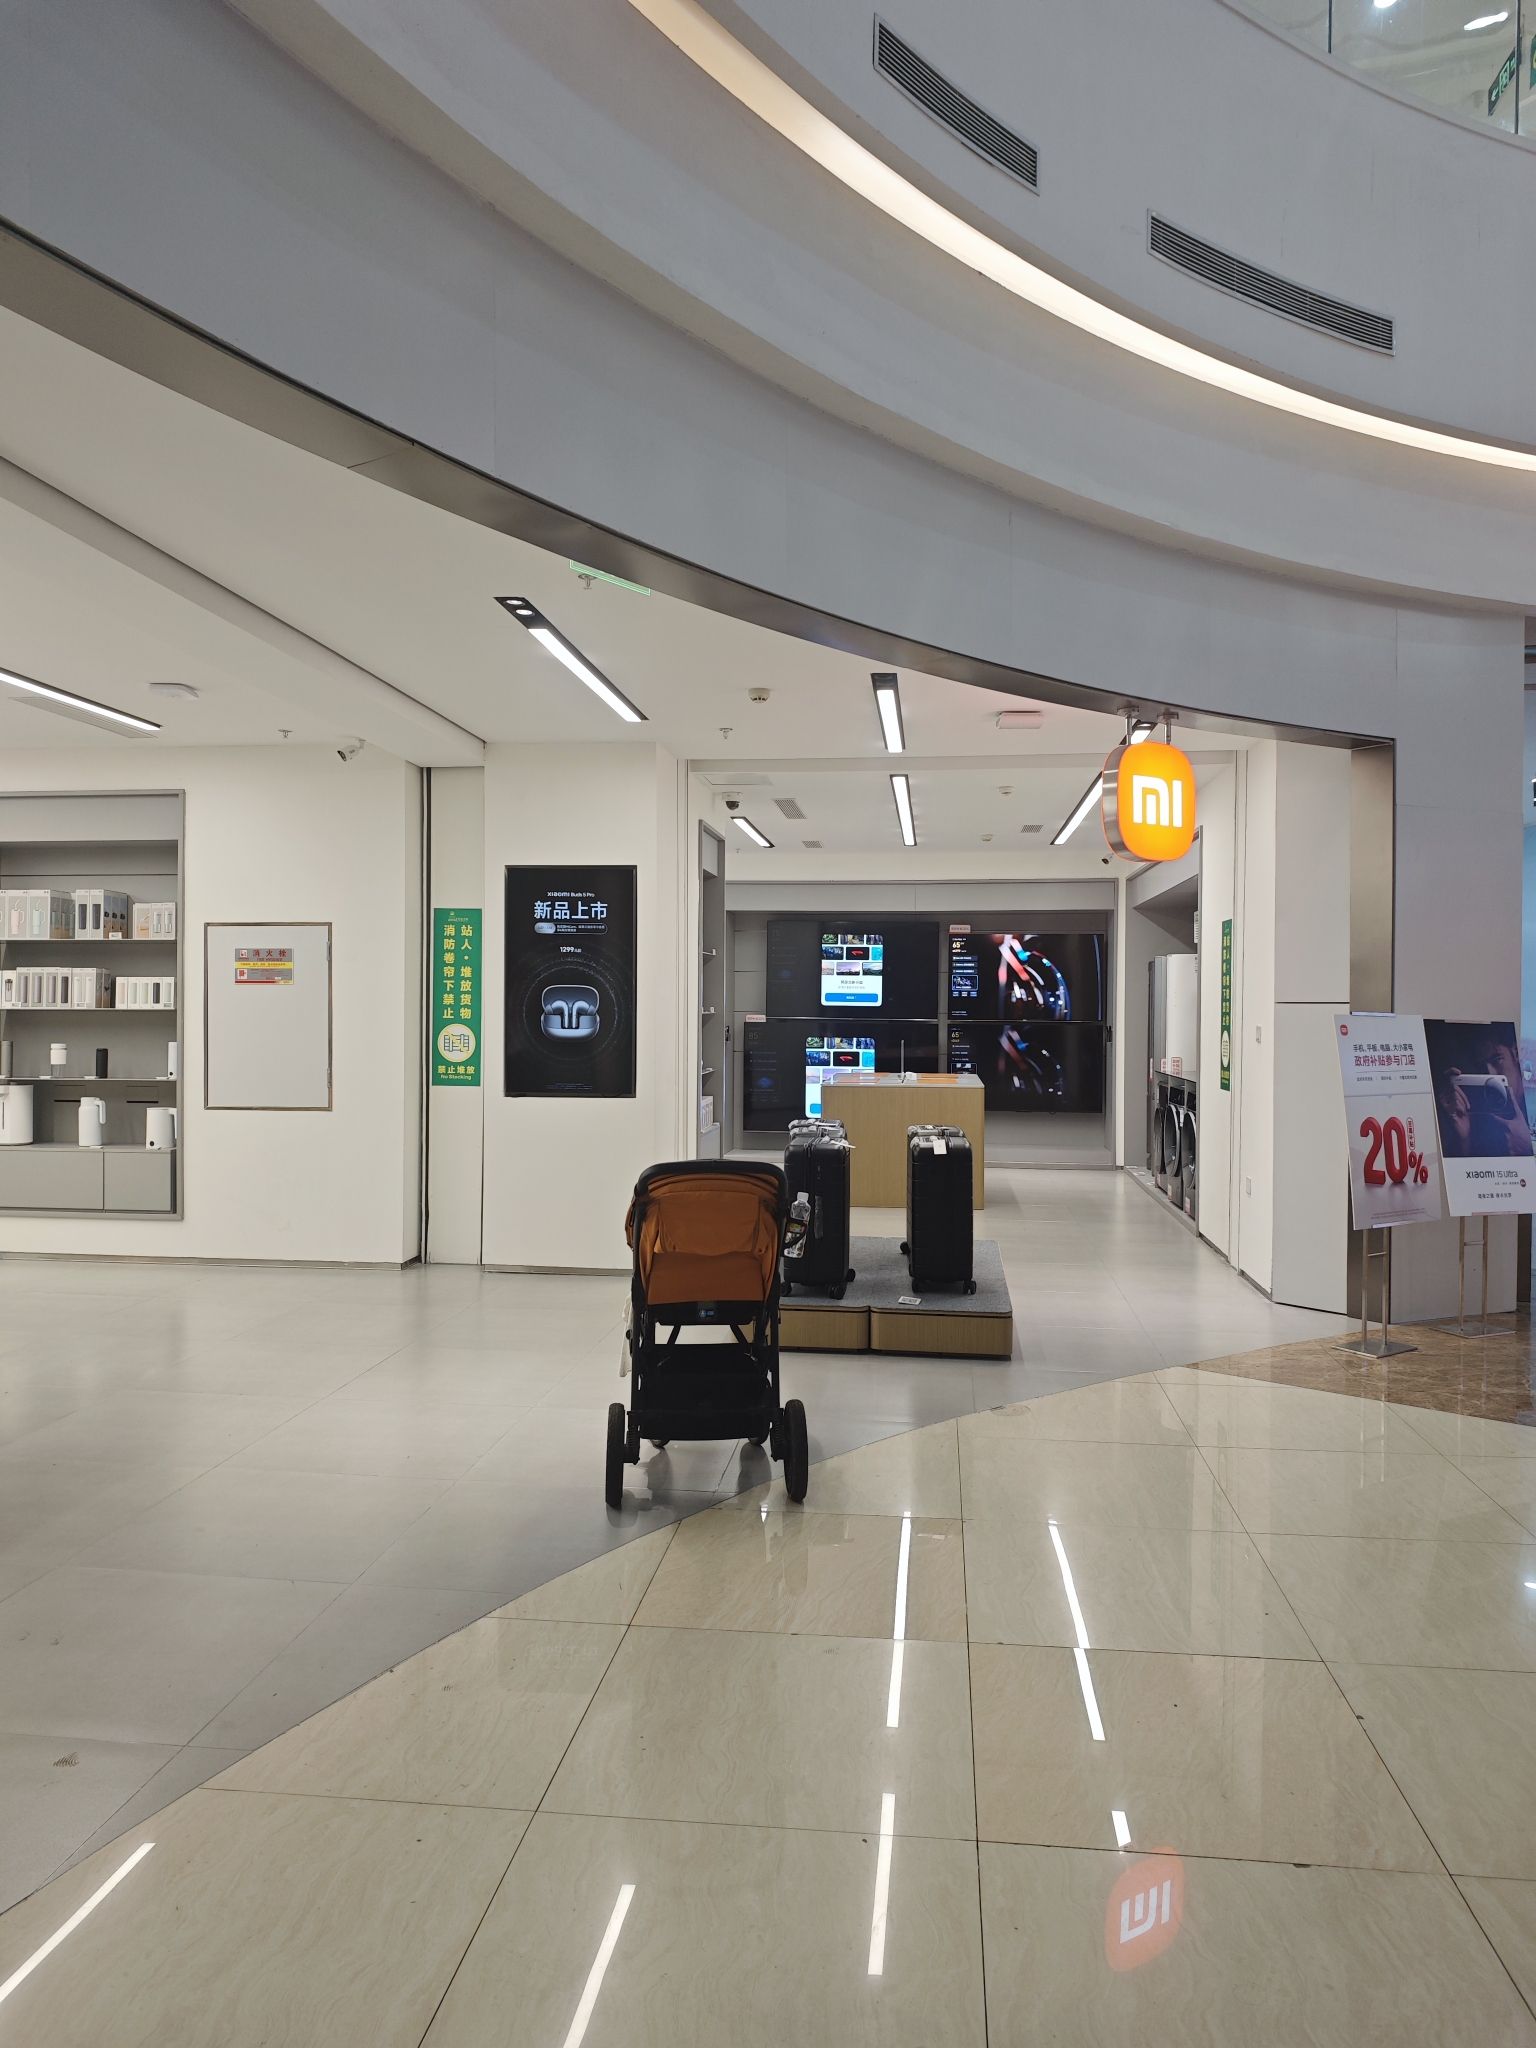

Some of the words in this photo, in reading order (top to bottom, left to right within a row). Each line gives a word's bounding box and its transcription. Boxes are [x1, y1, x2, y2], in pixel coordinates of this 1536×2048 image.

[533, 900, 608, 920] 新品上市
[442, 924, 456, 1020] 消防卷帘下禁止
[1354, 1053, 1416, 1068] 政府补贴参与门店
[437, 1065, 476, 1074] 禁止堆放
[1360, 1116, 1429, 1185] 20%
[1504, 1169, 1518, 1178] Ultra
